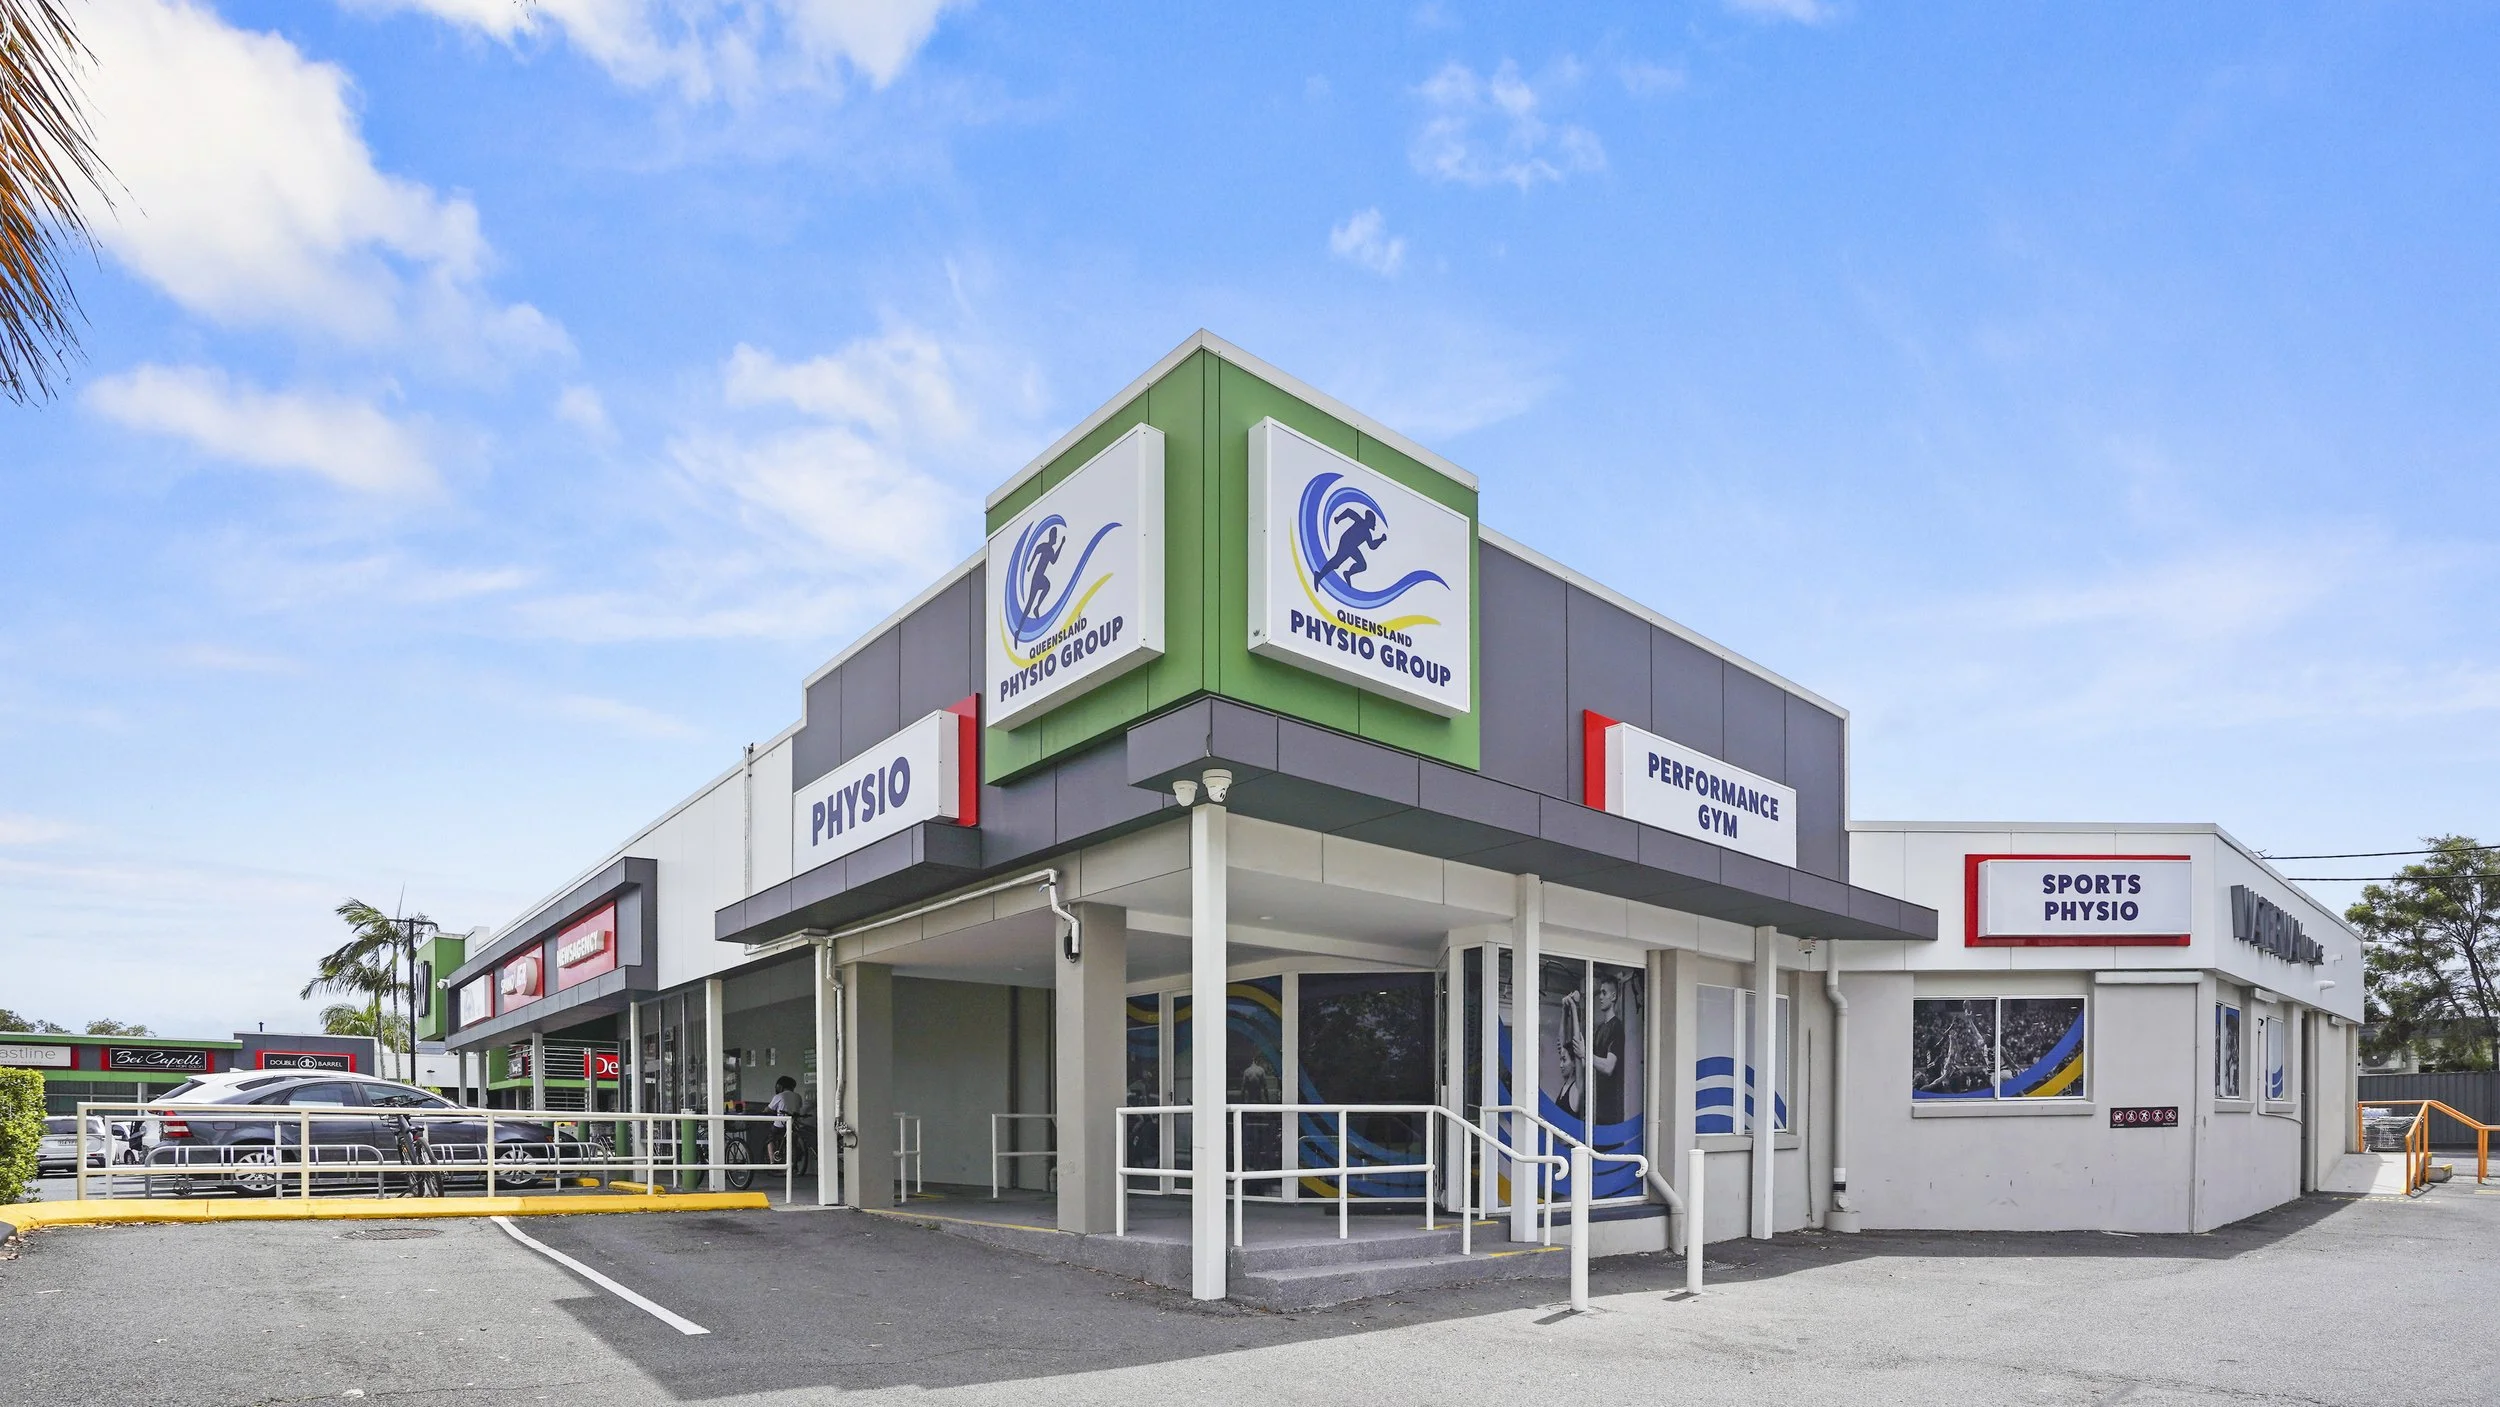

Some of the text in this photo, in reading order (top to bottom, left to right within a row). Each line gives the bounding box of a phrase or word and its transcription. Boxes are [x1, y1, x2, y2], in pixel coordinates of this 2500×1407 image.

[1029, 617, 1088, 659] QUEENSLAND
[1290, 609, 1451, 687] PHYSIO GROUP
[1337, 609, 1412, 648] QUEENSLAND
[1000, 615, 1124, 702] PHYSIO GROUP
[812, 756, 911, 847] PHYSIO
[1648, 751, 1779, 822] PERFORMANCE
[1698, 804, 1738, 839] GYM
[2042, 874, 2141, 894] SPORTS
[2044, 901, 2139, 921] PHYSIO
[556, 929, 599, 969] NEWSAGENCY
[115, 1051, 203, 1068] Bei Capelli
[317, 1060, 343, 1068] BARREL
